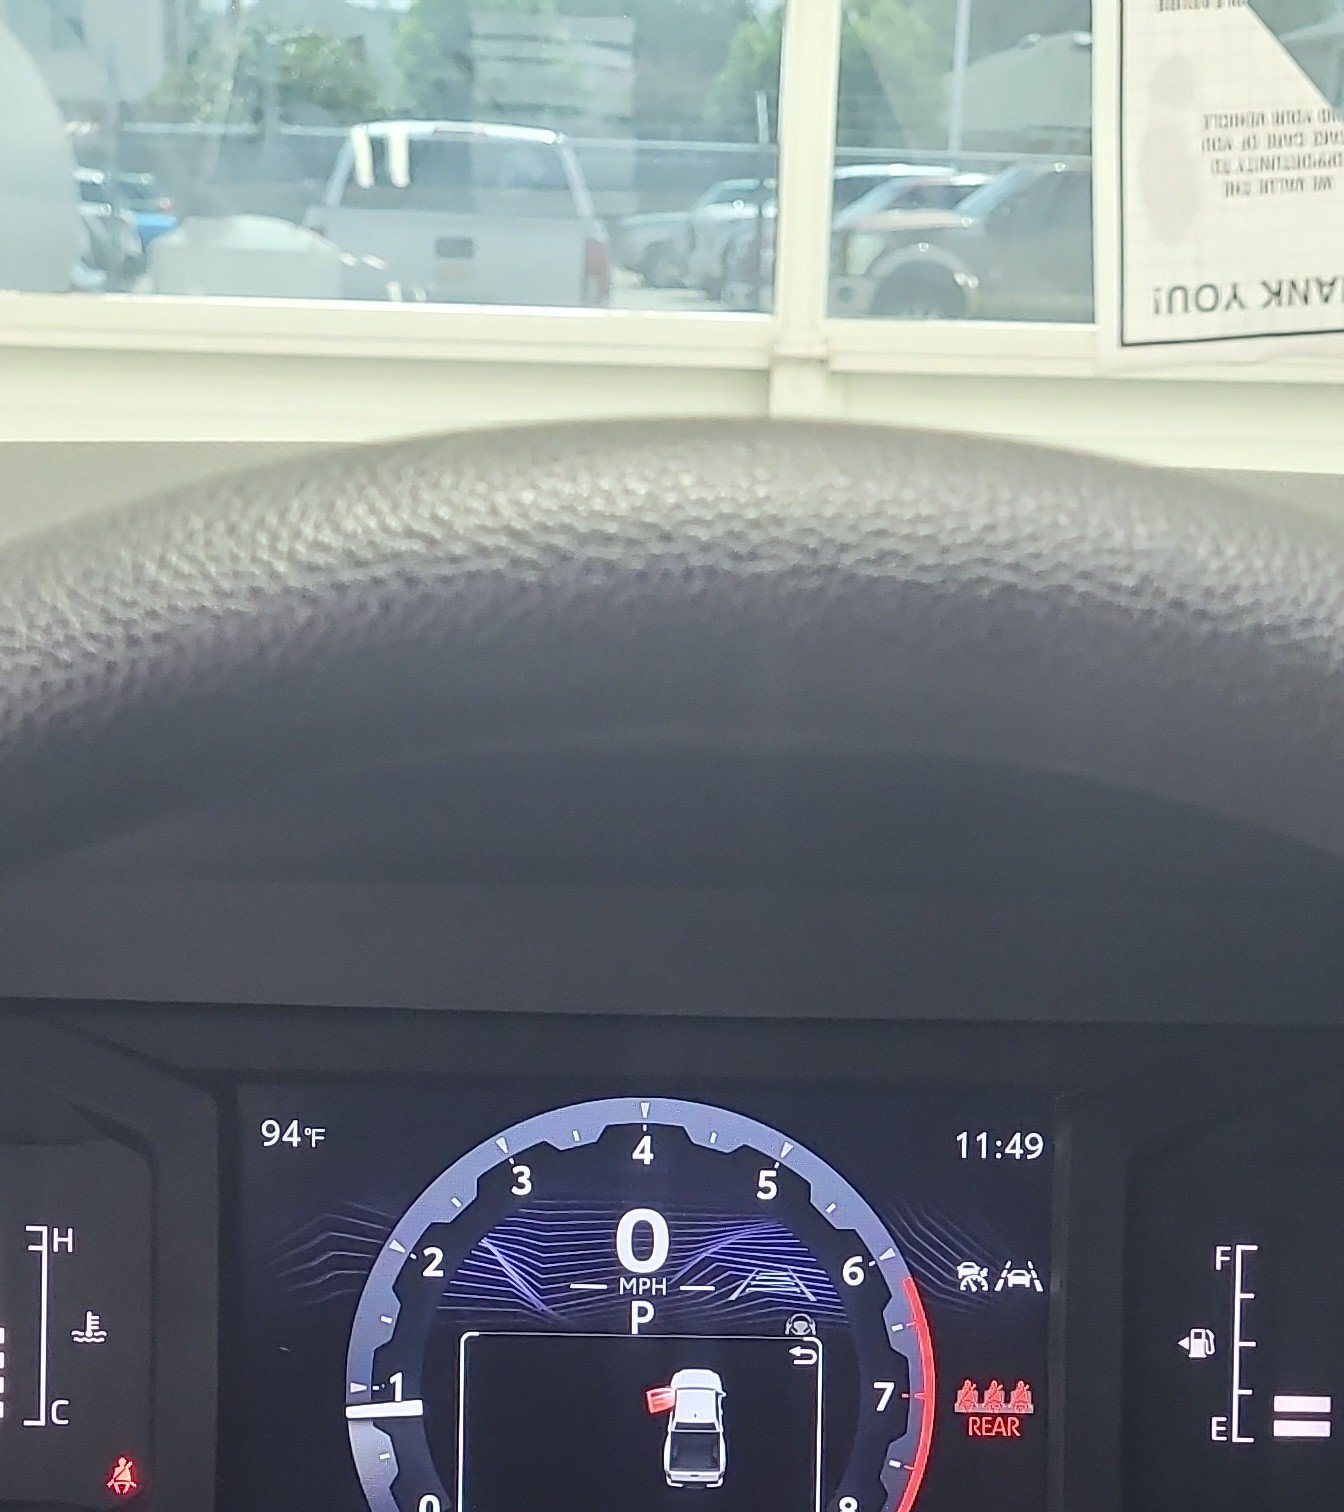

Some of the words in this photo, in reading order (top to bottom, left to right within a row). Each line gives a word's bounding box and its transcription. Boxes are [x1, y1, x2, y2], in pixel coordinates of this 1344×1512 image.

[1154, 285, 1248, 316] YOU!
[631, 1135, 655, 1166] 4
[956, 1131, 1044, 1160] 11:49
[510, 1167, 533, 1196] 3
[755, 1170, 779, 1201] 5
[52, 1227, 74, 1253] H
[614, 1207, 671, 1274] 0
[422, 1246, 444, 1278] 2
[842, 1255, 865, 1287] 6
[1215, 1245, 1232, 1271] F
[618, 1277, 668, 1297] MPH
[630, 1302, 655, 1334] P
[388, 1372, 405, 1403] 1
[873, 1381, 895, 1412] 7
[51, 1399, 70, 1425] C
[967, 1416, 1023, 1438] REAR
[1211, 1416, 1228, 1441] E
